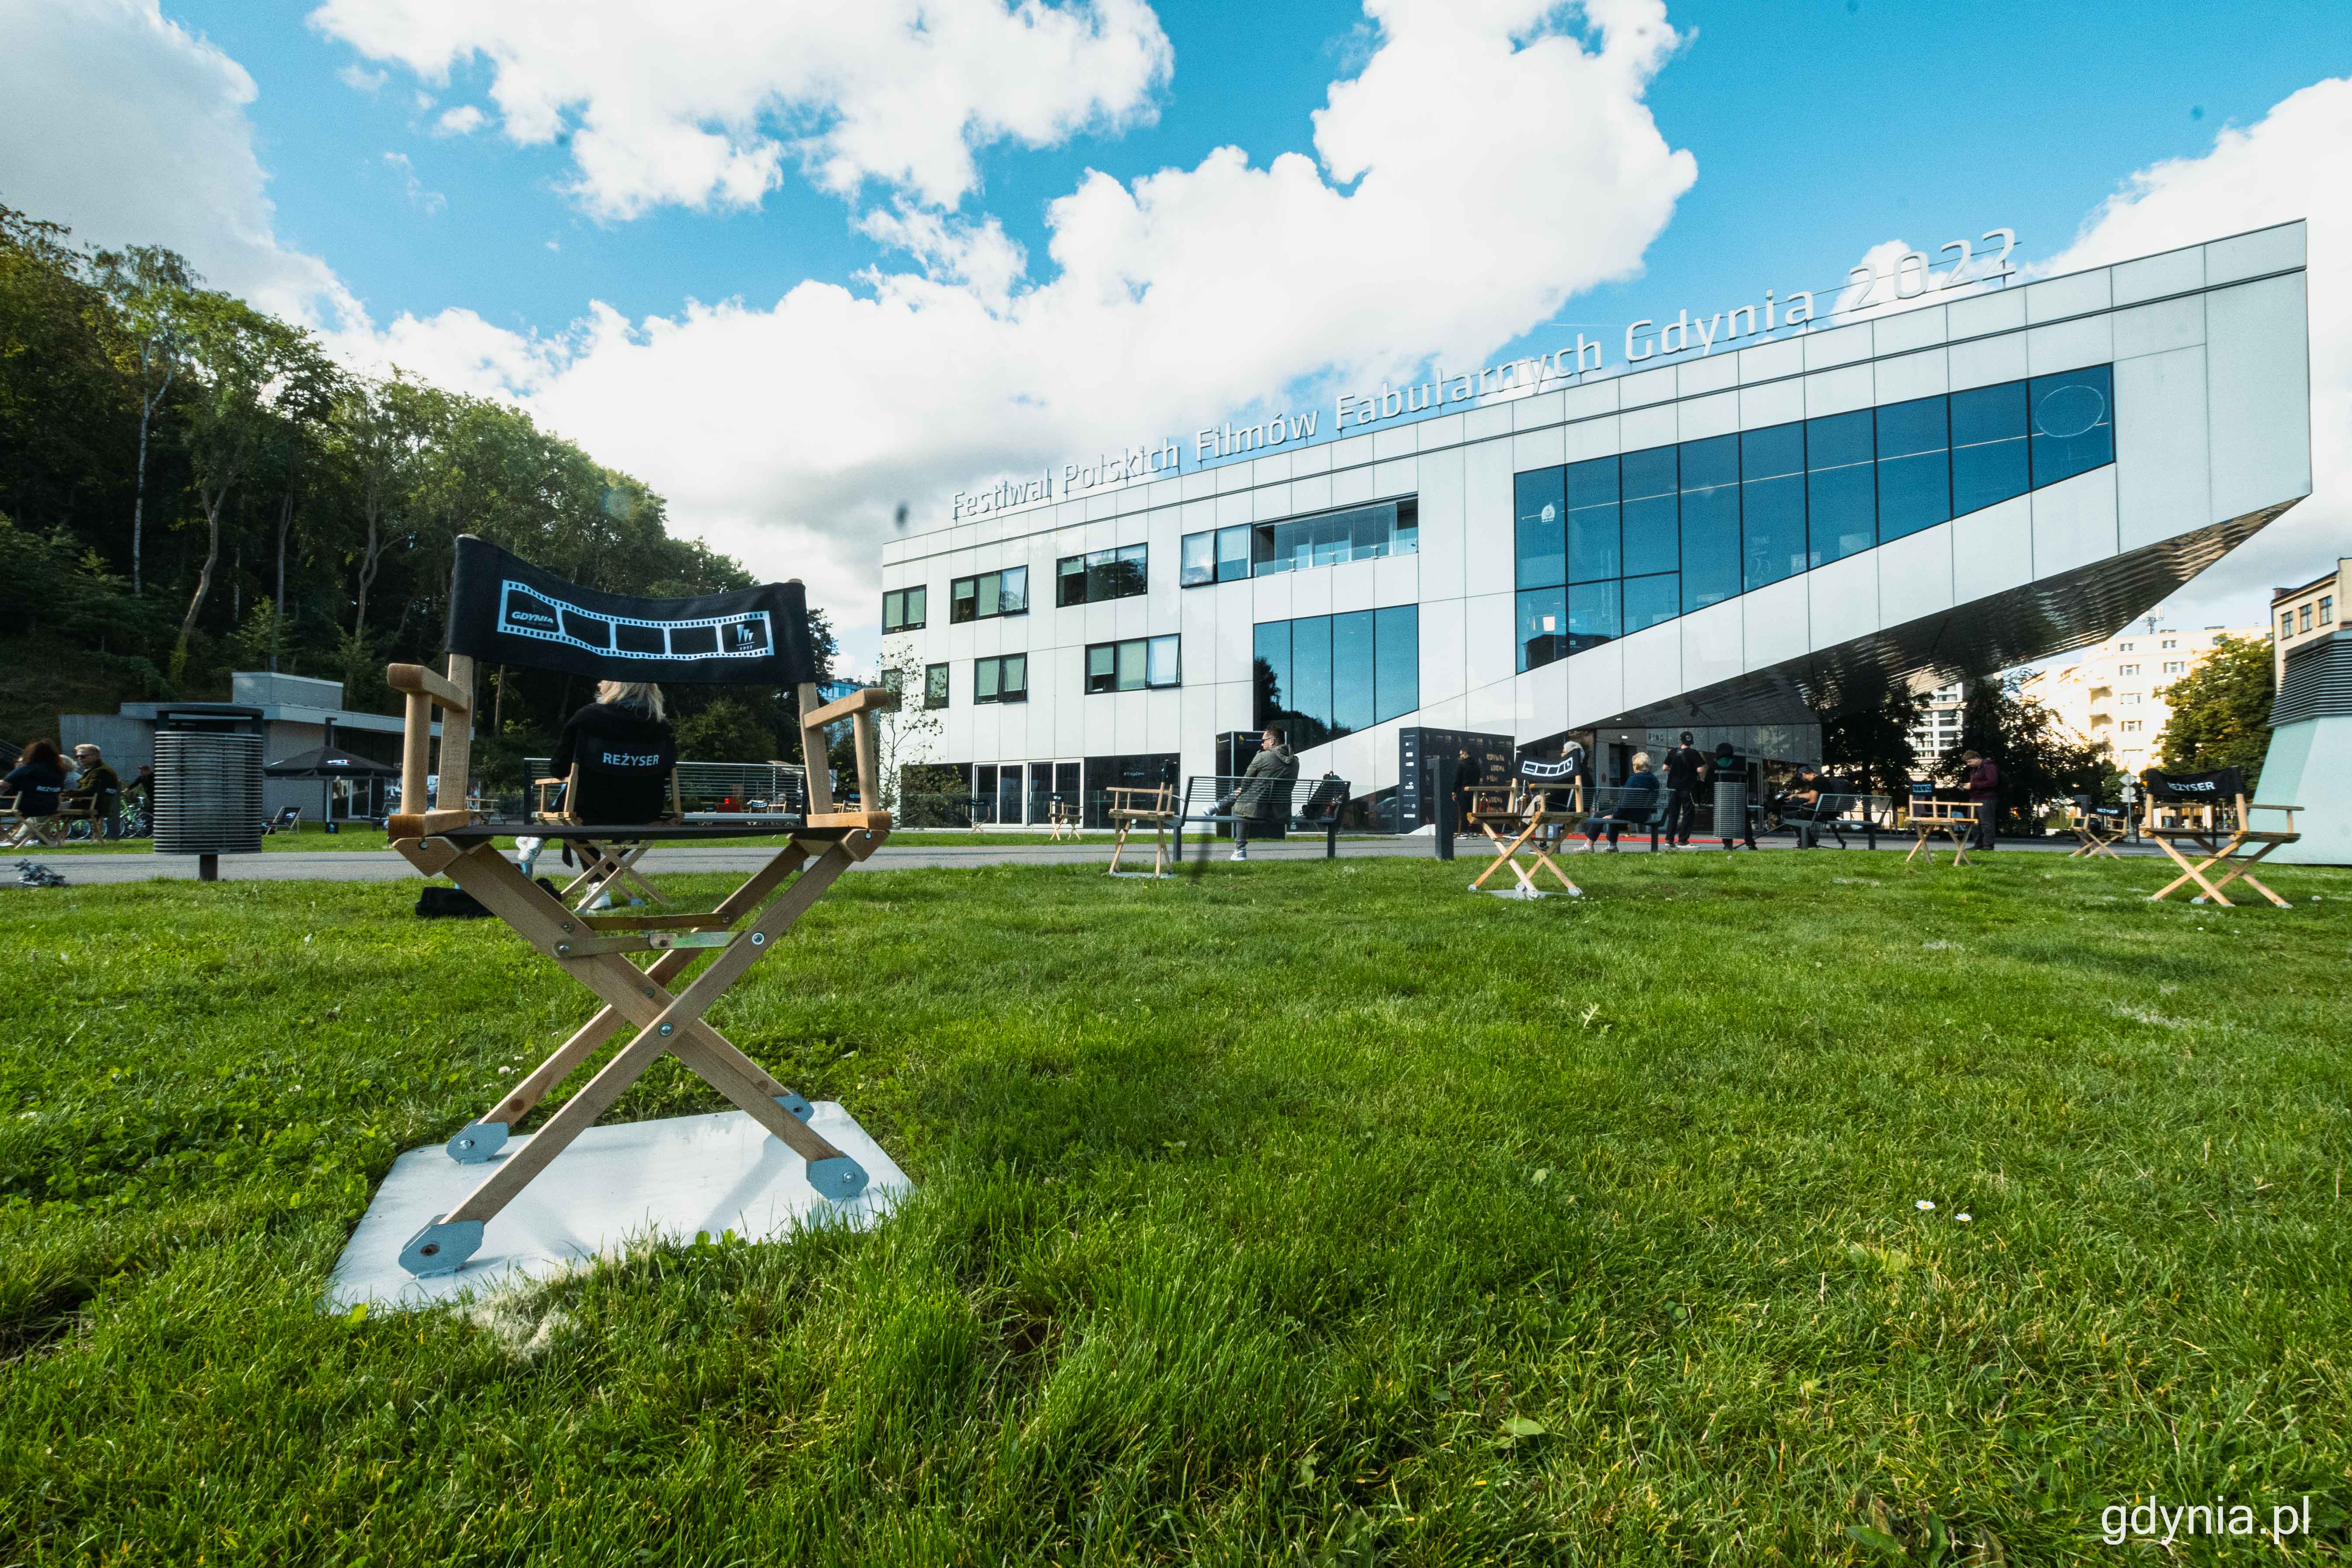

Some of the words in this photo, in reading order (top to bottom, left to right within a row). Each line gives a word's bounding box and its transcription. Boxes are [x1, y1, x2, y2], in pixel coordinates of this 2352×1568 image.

[952, 468, 1052, 519] Festiwal
[1063, 437, 1180, 493] Polskich
[1196, 410, 1320, 461] Filmów
[1336, 333, 1601, 430] Fabularnych
[1625, 289, 1814, 362] Gdynia
[1849, 228, 2016, 312] 2022
[512, 611, 554, 624] GDYNIA
[603, 752, 659, 766] REŻYSER
[2167, 782, 2216, 791] REŻYSER
